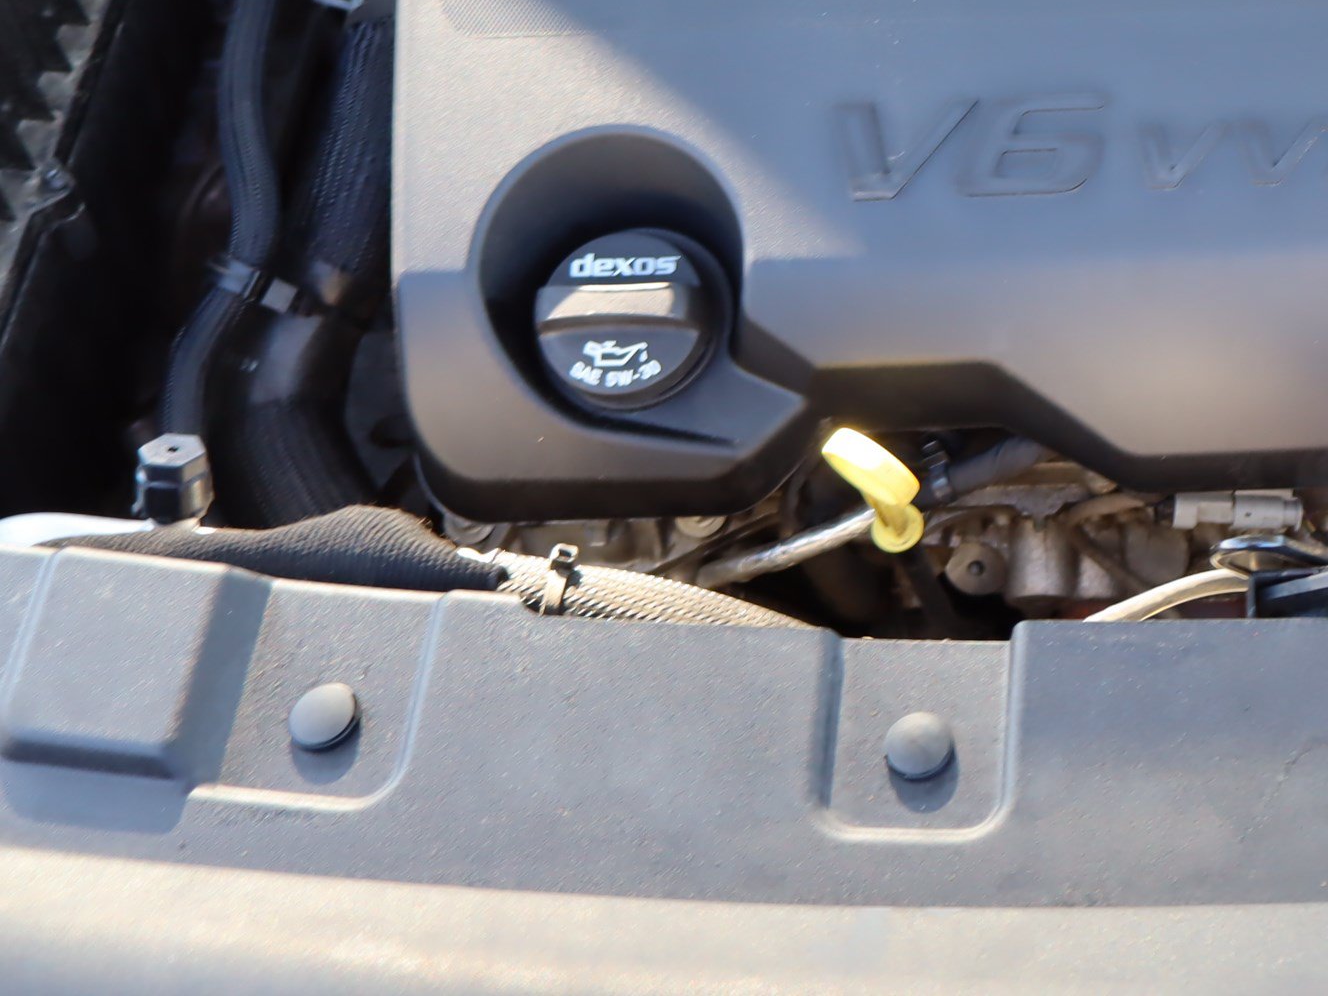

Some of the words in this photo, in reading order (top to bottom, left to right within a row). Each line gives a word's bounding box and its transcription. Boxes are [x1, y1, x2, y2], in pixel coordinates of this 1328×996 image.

[832, 96, 1107, 202] V6
[569, 253, 681, 278] dexos
[569, 361, 603, 386] SAE
